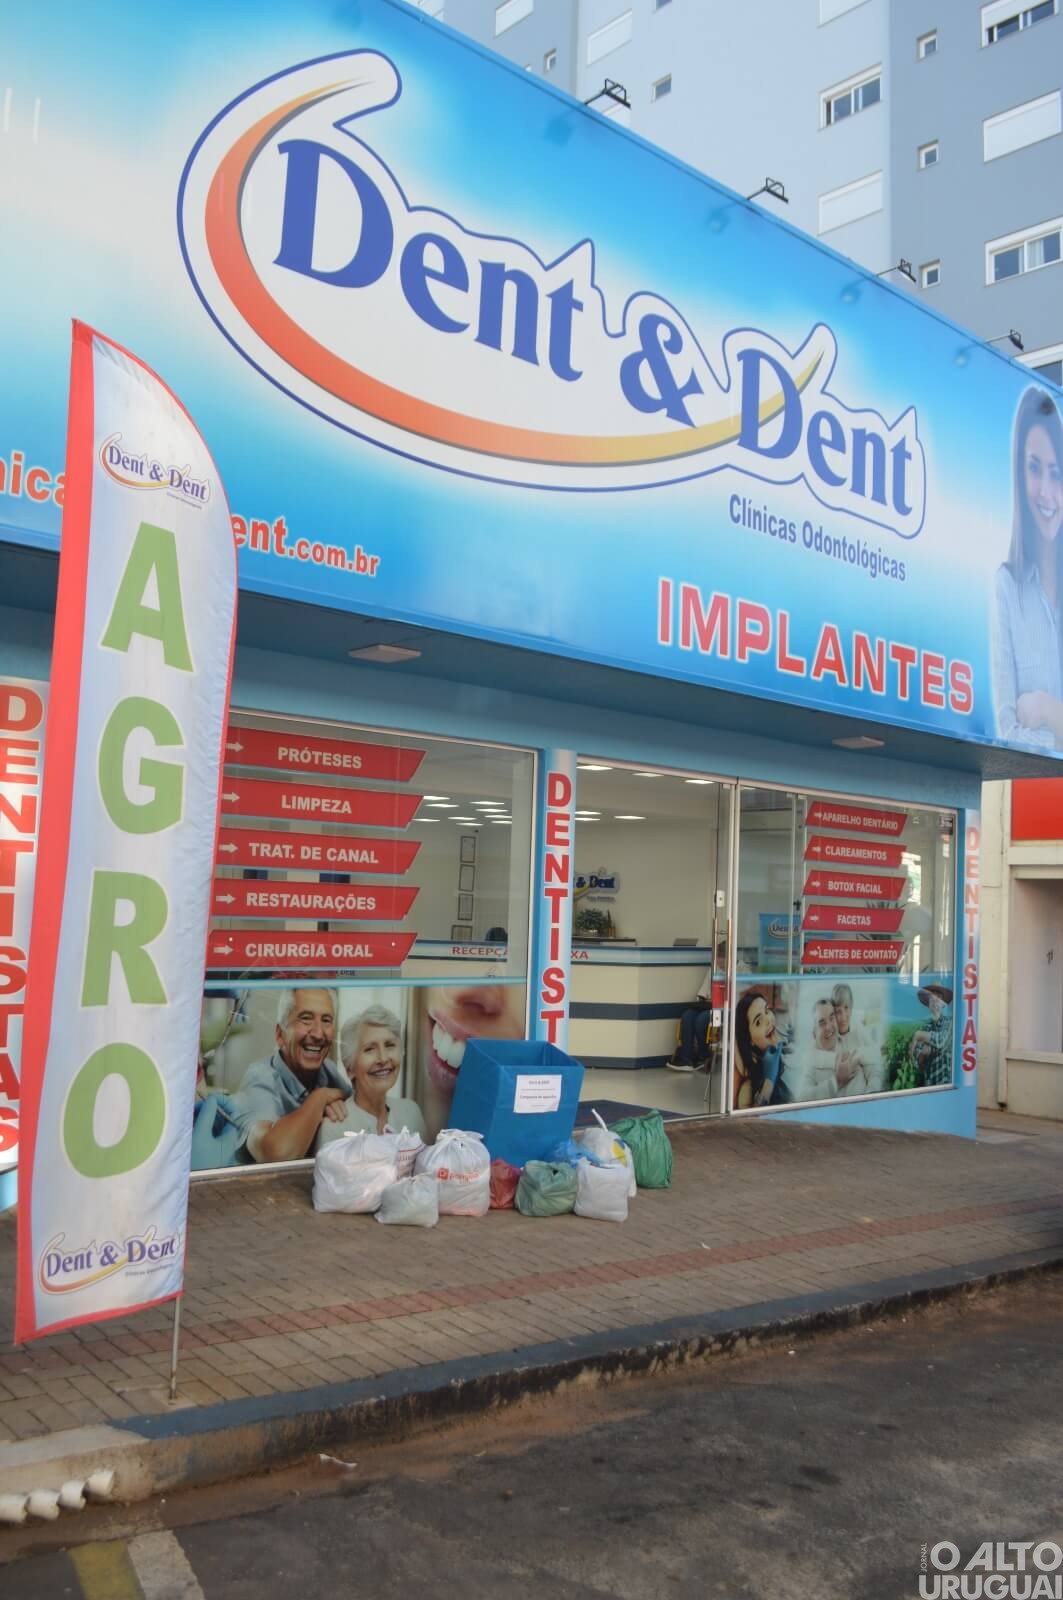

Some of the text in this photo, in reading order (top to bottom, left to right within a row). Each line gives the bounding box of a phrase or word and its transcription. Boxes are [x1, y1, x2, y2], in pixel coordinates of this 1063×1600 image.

[274, 139, 916, 518] Dent & Dent
[108, 445, 208, 500] Dent & Dent
[729, 493, 906, 582] Clínicas Odontológicas
[656, 577, 975, 715] IMPLANTES
[277, 746, 363, 769] PRÓTESES
[281, 794, 353, 815] LIMPEZA
[822, 813, 898, 831] APARELHO DENTÁRIO
[62, 521, 195, 1179] AGRO
[249, 842, 379, 864] TRAT. DE CANAL
[825, 845, 888, 861] CLAREAMENTOS
[827, 880, 883, 894] BOTOX FACIAL
[245, 891, 377, 913] RESTAURAÇÕES
[837, 914, 872, 926] FACETAS
[245, 943, 373, 959] CIRURGIA ORAL
[818, 947, 898, 960] LENTES DE CONTATO
[961, 826, 979, 1072] DENTISTAS
[46, 1238, 176, 1278] Dent & Dent
